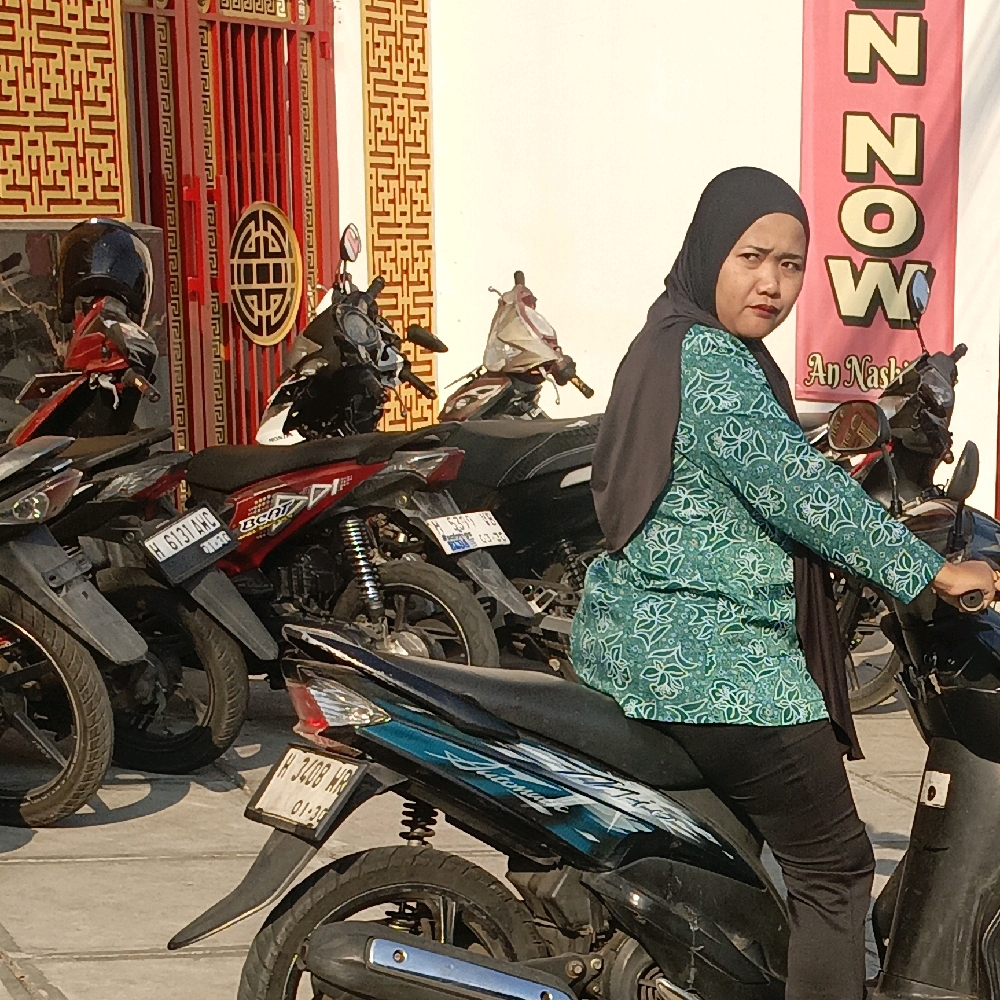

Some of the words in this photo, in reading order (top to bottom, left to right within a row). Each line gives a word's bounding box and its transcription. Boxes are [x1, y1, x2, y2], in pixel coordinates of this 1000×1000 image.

[825, 110, 937, 330] NOW
[804, 351, 841, 389] An
[148, 541, 166, 560] H
[163, 523, 196, 551] 6131
[276, 753, 297, 779] H
